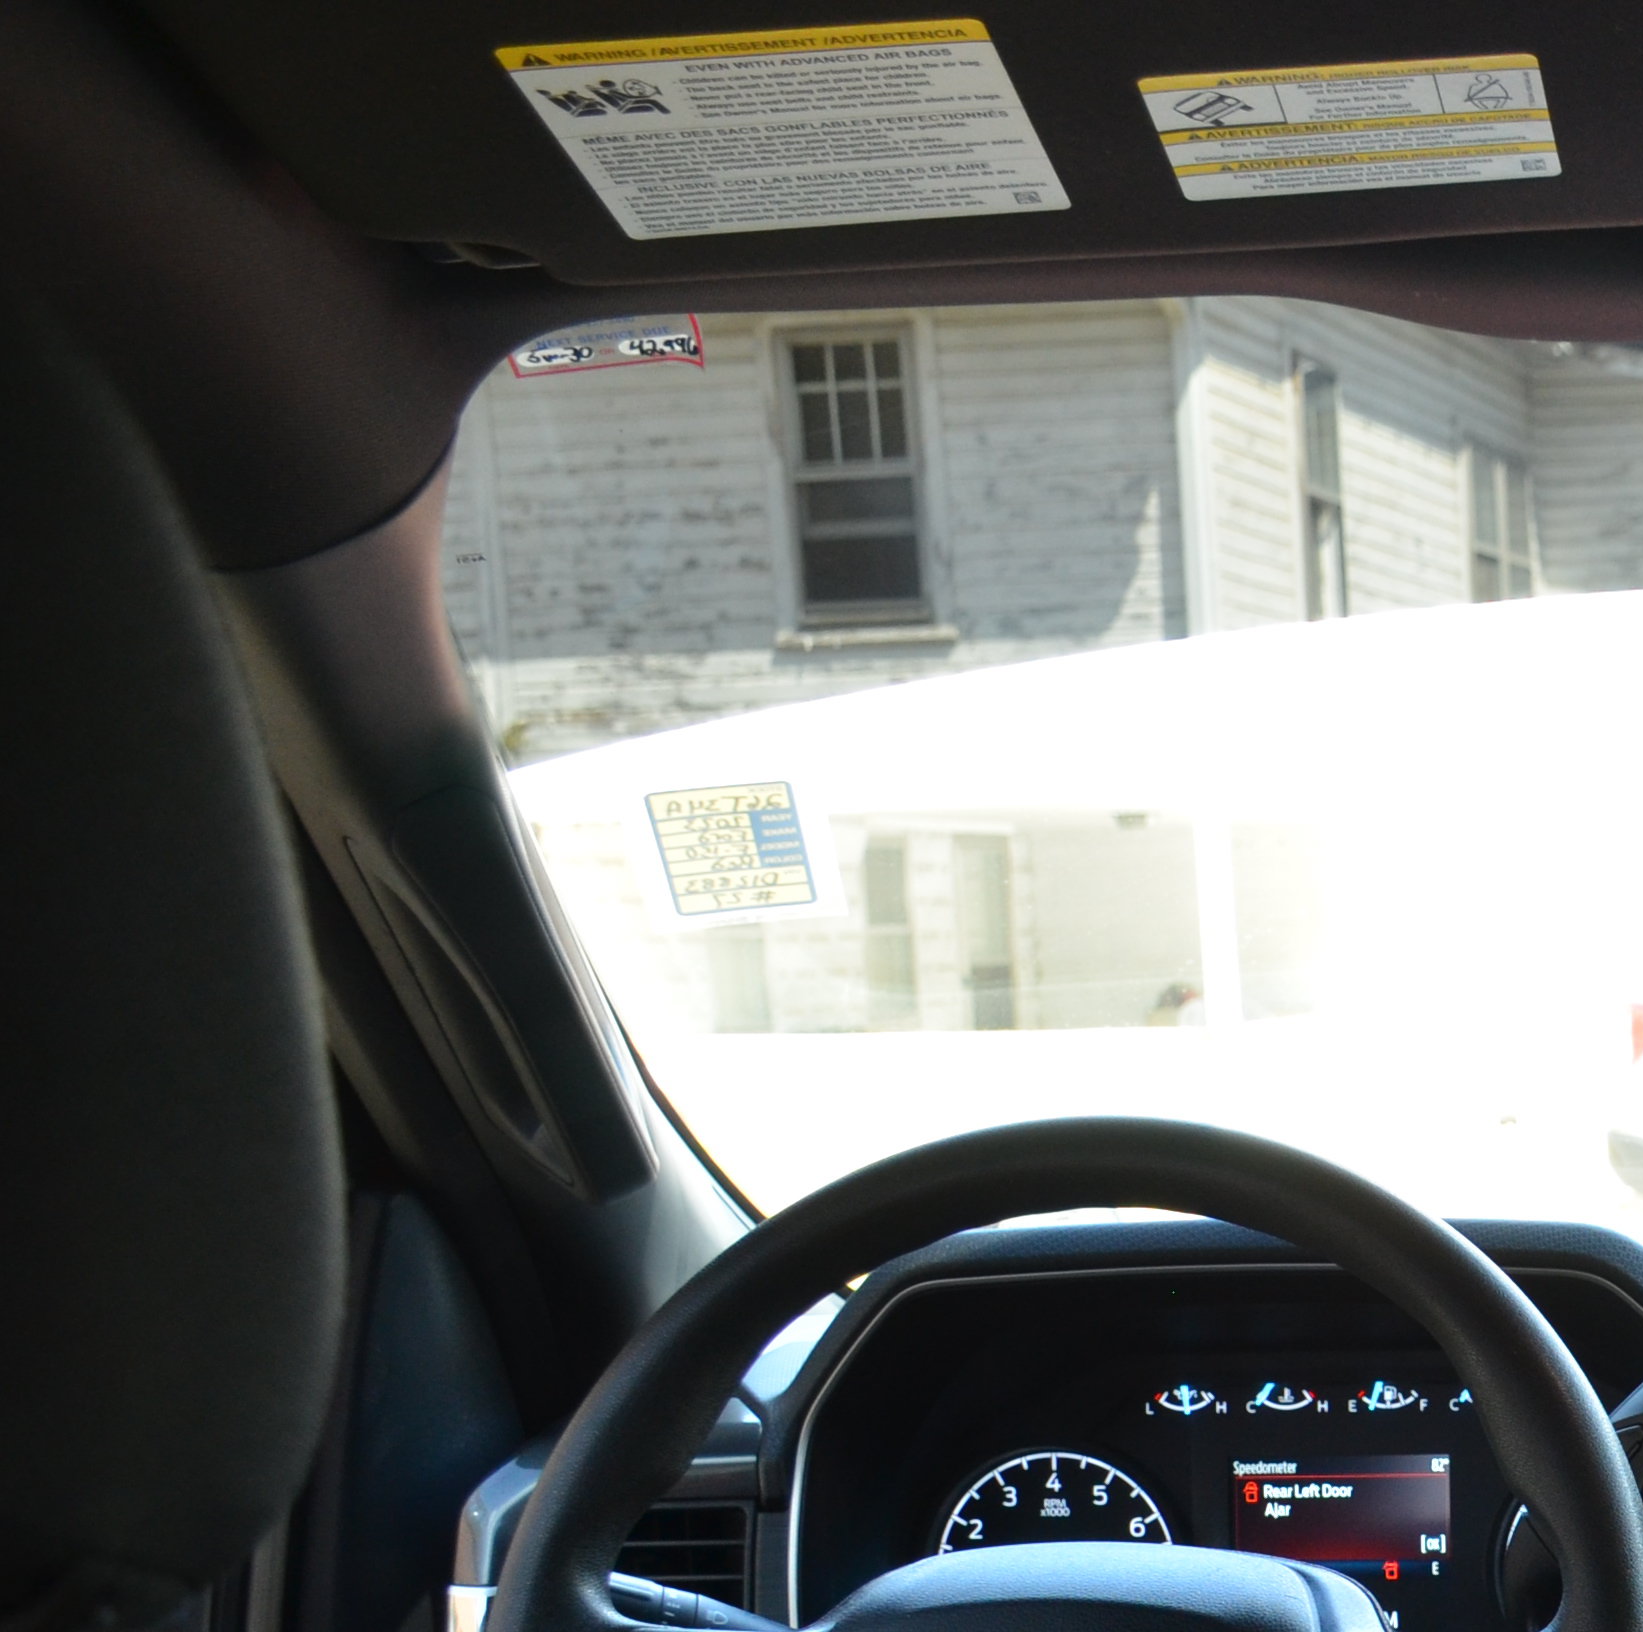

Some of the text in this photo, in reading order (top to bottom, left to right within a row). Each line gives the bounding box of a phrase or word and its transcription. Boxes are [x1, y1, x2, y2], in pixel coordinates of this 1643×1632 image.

[554, 48, 646, 63] WARNING
[683, 47, 953, 73] EVEN WITH ADVANCED AIR BAGS
[577, 330, 634, 343] SERVICE
[642, 326, 672, 338] DUE
[1145, 1402, 1154, 1415] L
[1216, 1402, 1227, 1414] H
[1246, 1401, 1256, 1413] C
[1317, 1401, 1328, 1413] H
[1349, 1400, 1357, 1412] E
[1420, 1399, 1428, 1411] F
[1450, 1398, 1459, 1411] C
[1233, 1461, 1297, 1477] Speedometer
[1045, 1473, 1062, 1492] 4
[1002, 1486, 1017, 1507] 3
[1092, 1485, 1108, 1505] 5
[1263, 1484, 1353, 1499] Rear Left Door
[1043, 1499, 1067, 1508] RPM
[1264, 1502, 1291, 1519] Ajar
[968, 1520, 983, 1540] 2
[1129, 1517, 1146, 1538] 6
[1431, 1561, 1439, 1575] E
